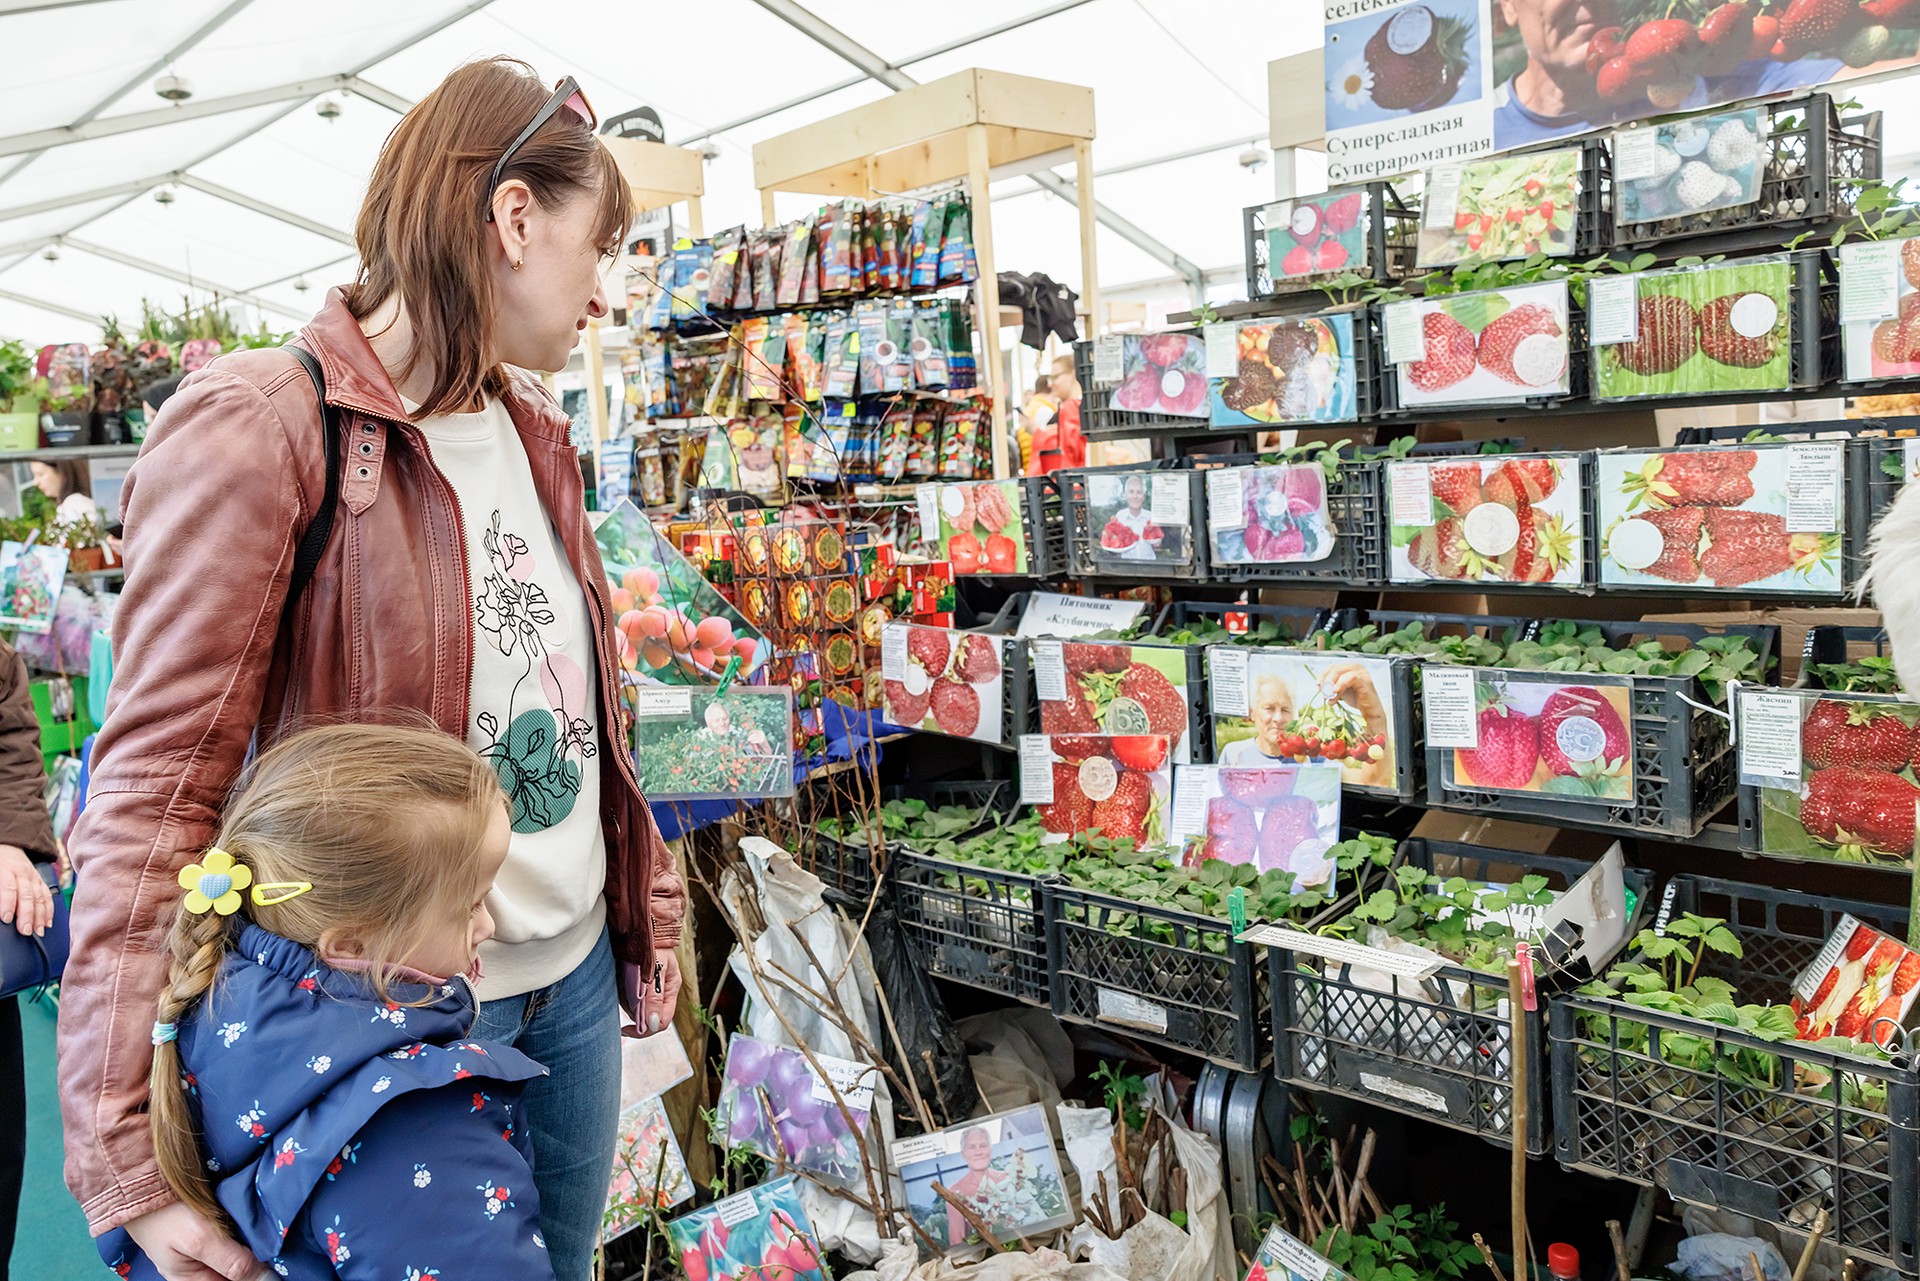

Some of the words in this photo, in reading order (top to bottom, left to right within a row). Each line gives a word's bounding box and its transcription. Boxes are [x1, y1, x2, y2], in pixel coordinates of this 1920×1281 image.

[1327, 116, 1463, 155] Суперсладкая
[1328, 138, 1491, 181] Суперароматная
[1060, 596, 1112, 611] Питомник
[1756, 695, 1792, 704] Жасмин
[1281, 1234, 1317, 1264] Жозефина
